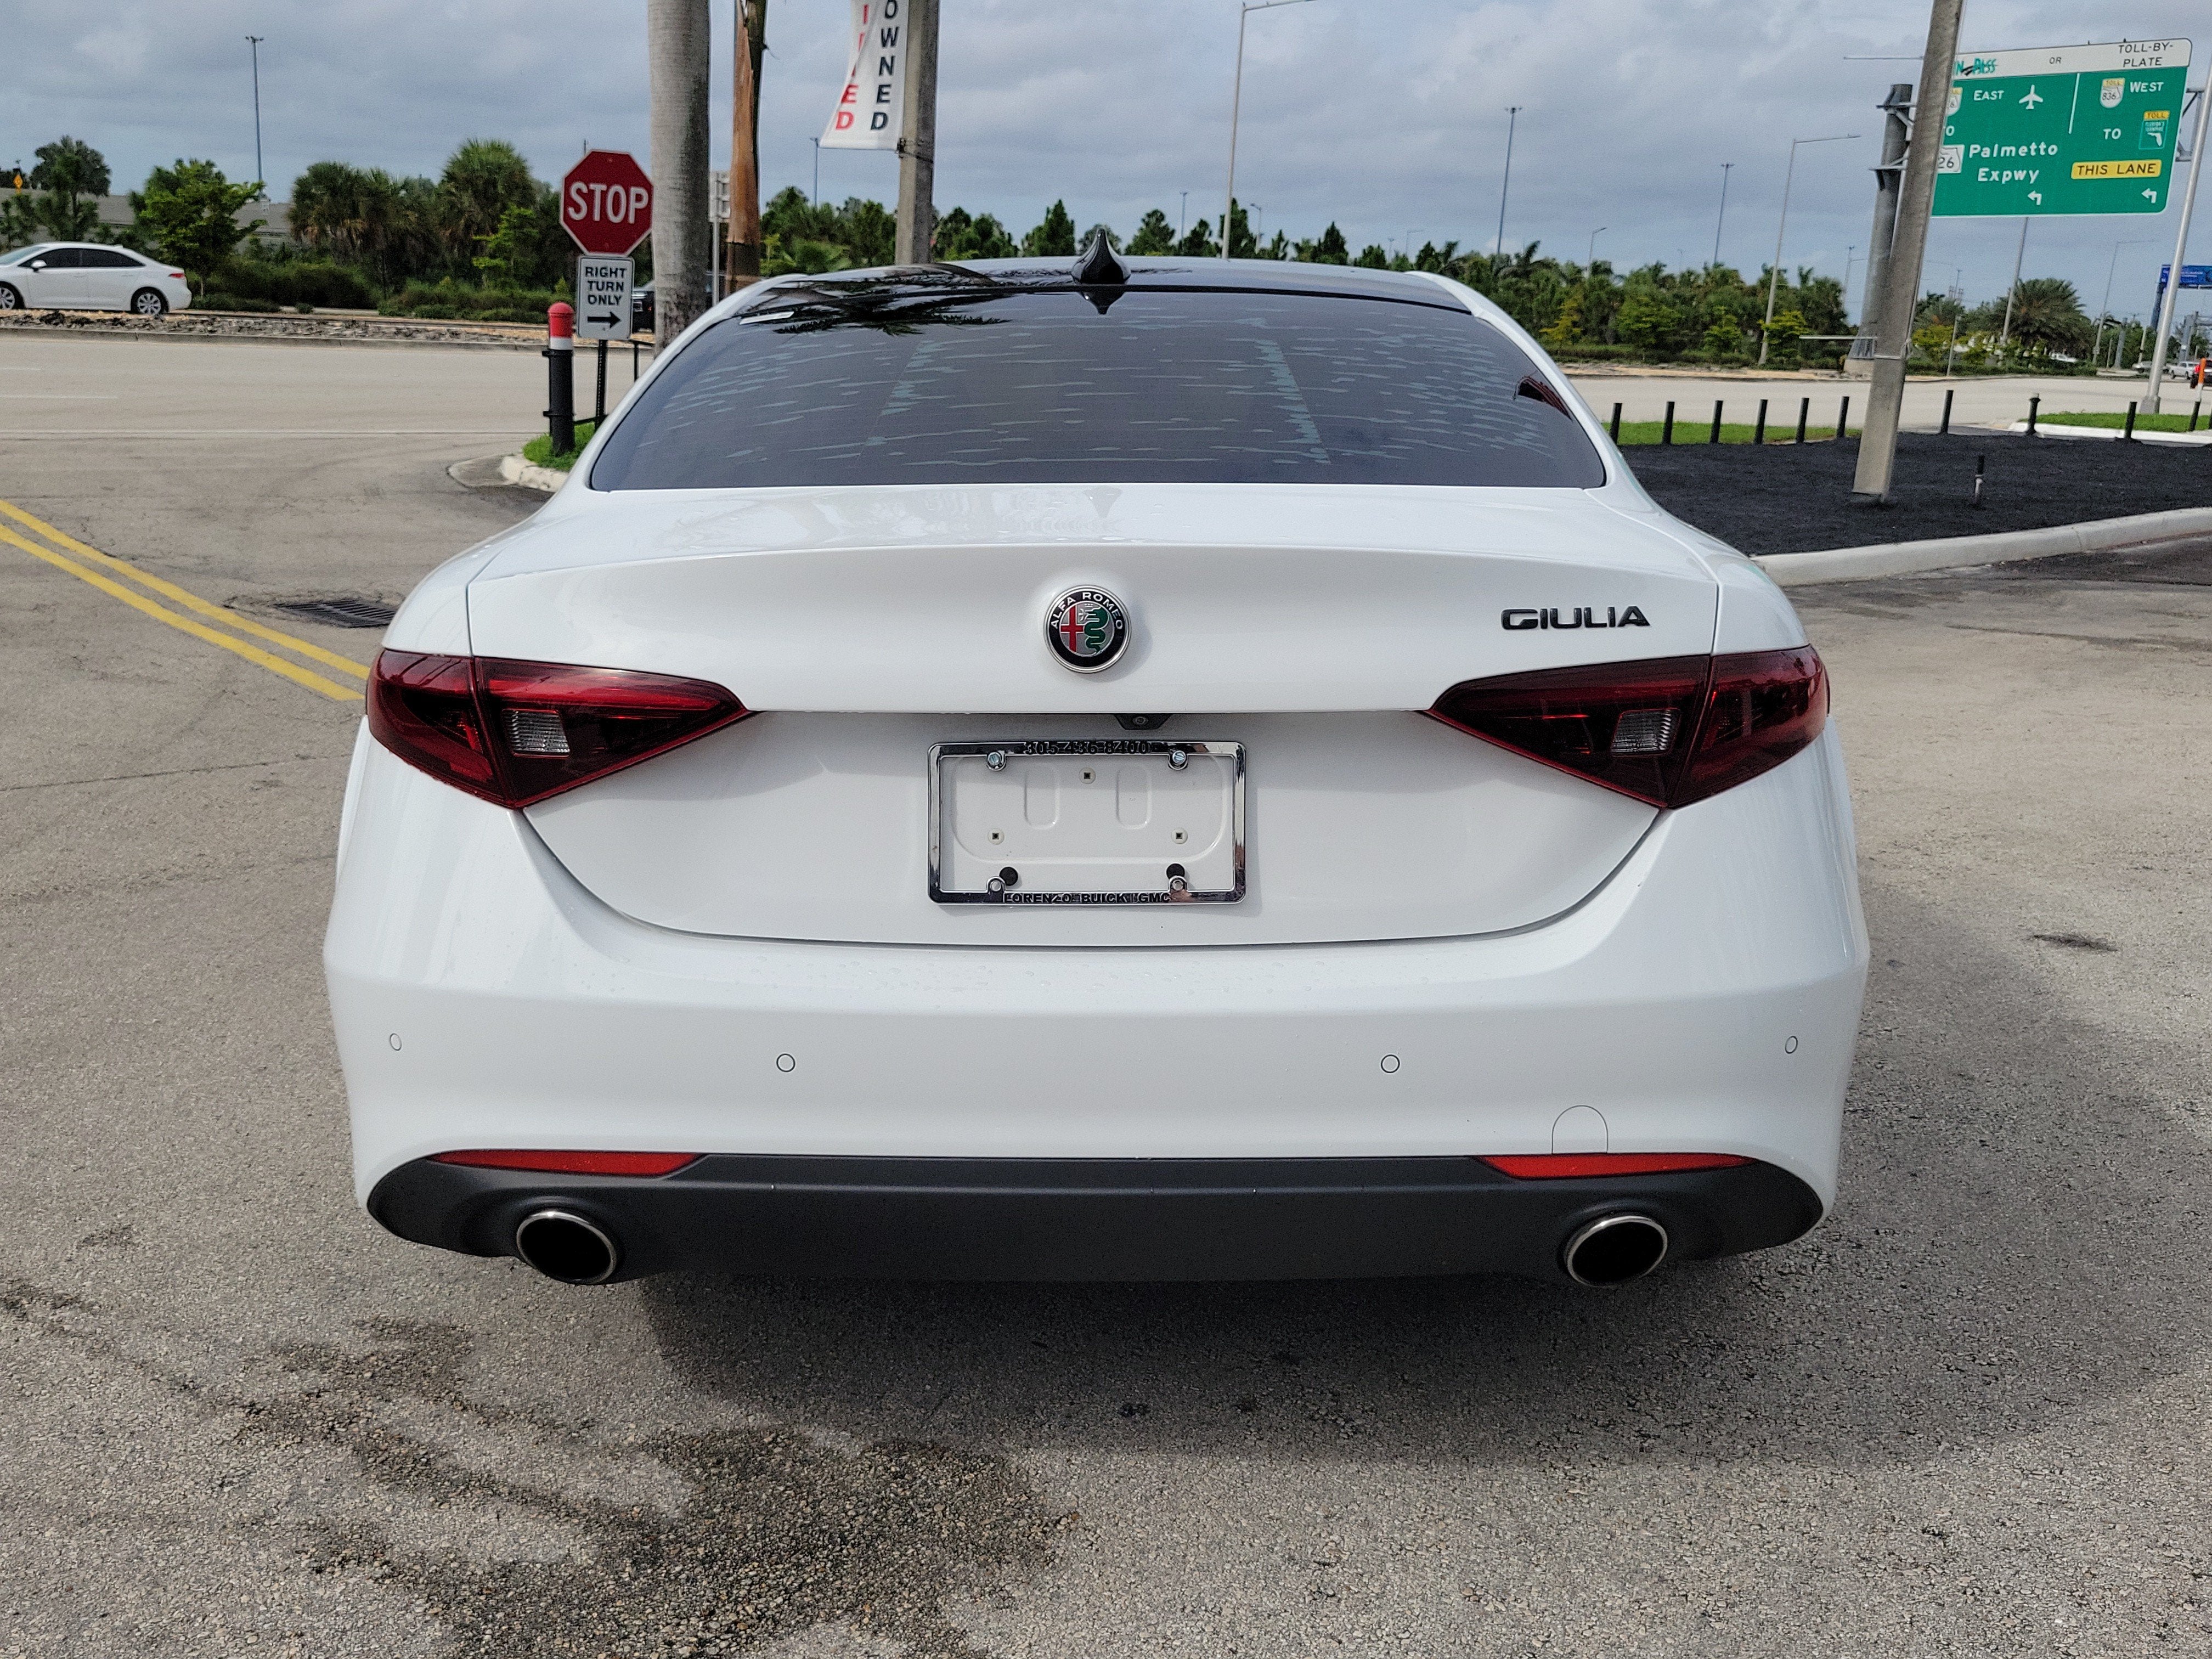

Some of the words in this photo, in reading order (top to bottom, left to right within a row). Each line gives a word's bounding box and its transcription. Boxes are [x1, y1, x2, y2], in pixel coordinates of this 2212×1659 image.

[871, 0, 899, 131] OWNED
[2049, 57, 2062, 65] OR
[2123, 57, 2163, 67] PLATE
[2130, 81, 2164, 93] WEST
[1973, 89, 2005, 101] EAST
[2102, 92, 2117, 100] 836
[1945, 125, 1955, 136] O
[2103, 128, 2121, 140] TO
[1969, 142, 2058, 158] Palmetto
[1938, 156, 1954, 169] 26
[1978, 167, 2040, 184] Expwy
[2077, 165, 2108, 176] THIS
[2117, 163, 2157, 174] LANE
[568, 182, 648, 224] STOP
[585, 266, 628, 278] RIGHT
[588, 280, 624, 292] TURN
[588, 295, 622, 306] ONLY
[1051, 596, 1076, 629] ALFA
[1082, 592, 1123, 630] ROMEO
[1501, 606, 1651, 630] GIULIA
[1004, 893, 1071, 903] LORENZO
[1081, 893, 1127, 903] BUICK
[1138, 892, 1171, 902] GMC
